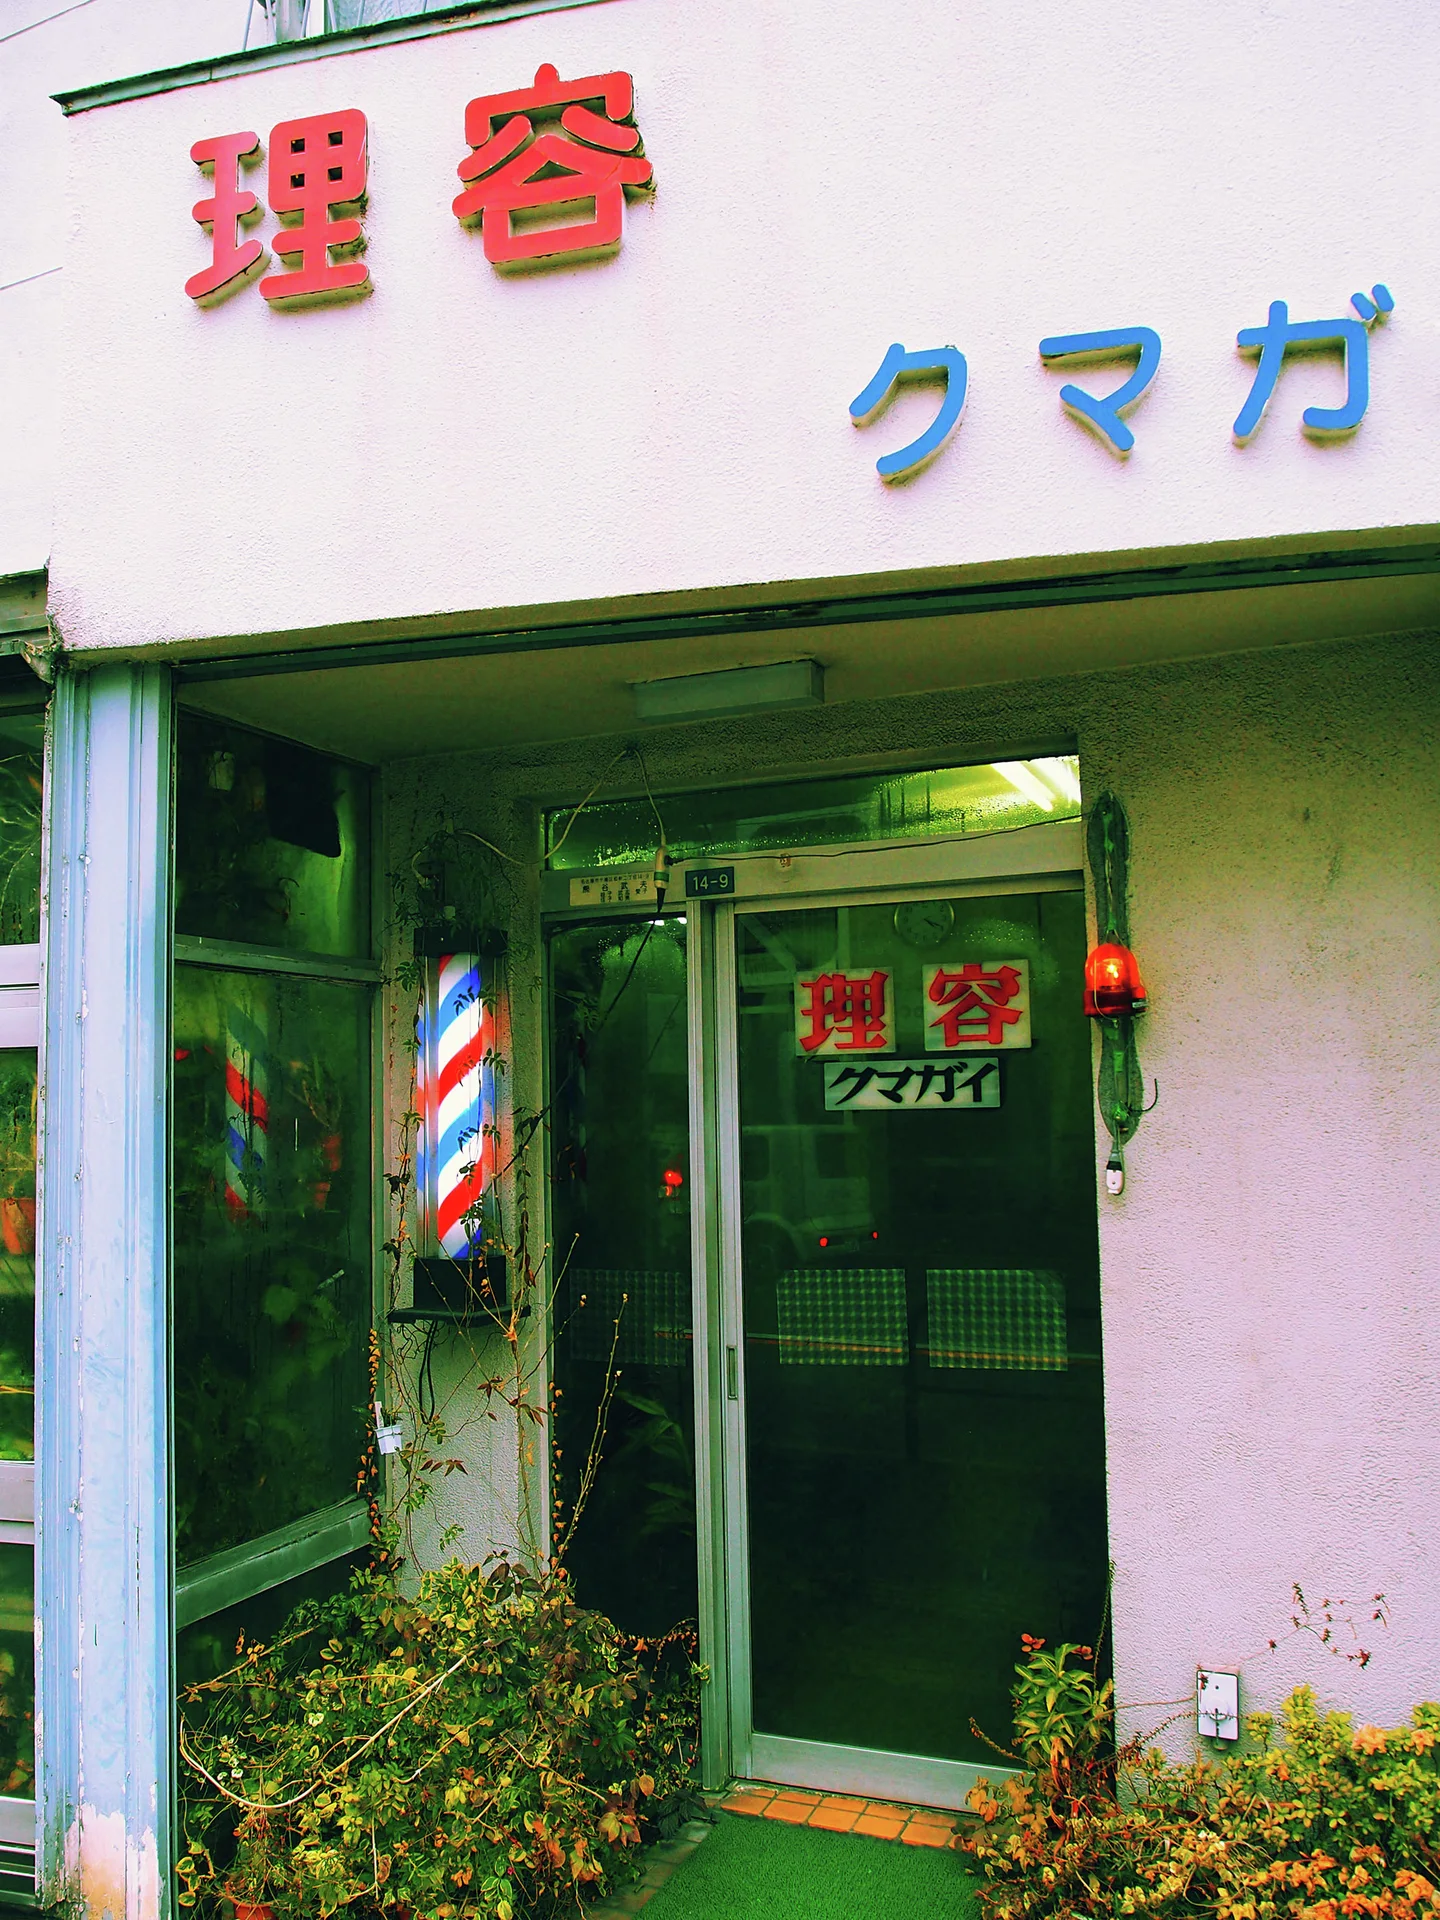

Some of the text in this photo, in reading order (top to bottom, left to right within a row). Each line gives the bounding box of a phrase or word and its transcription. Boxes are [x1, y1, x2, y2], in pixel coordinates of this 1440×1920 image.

[184, 63, 654, 300] 理容
[848, 282, 1396, 479] クマガ
[693, 873, 729, 890] 14-9
[799, 963, 1024, 1052] 理容
[828, 1061, 998, 1106] クマガイ
